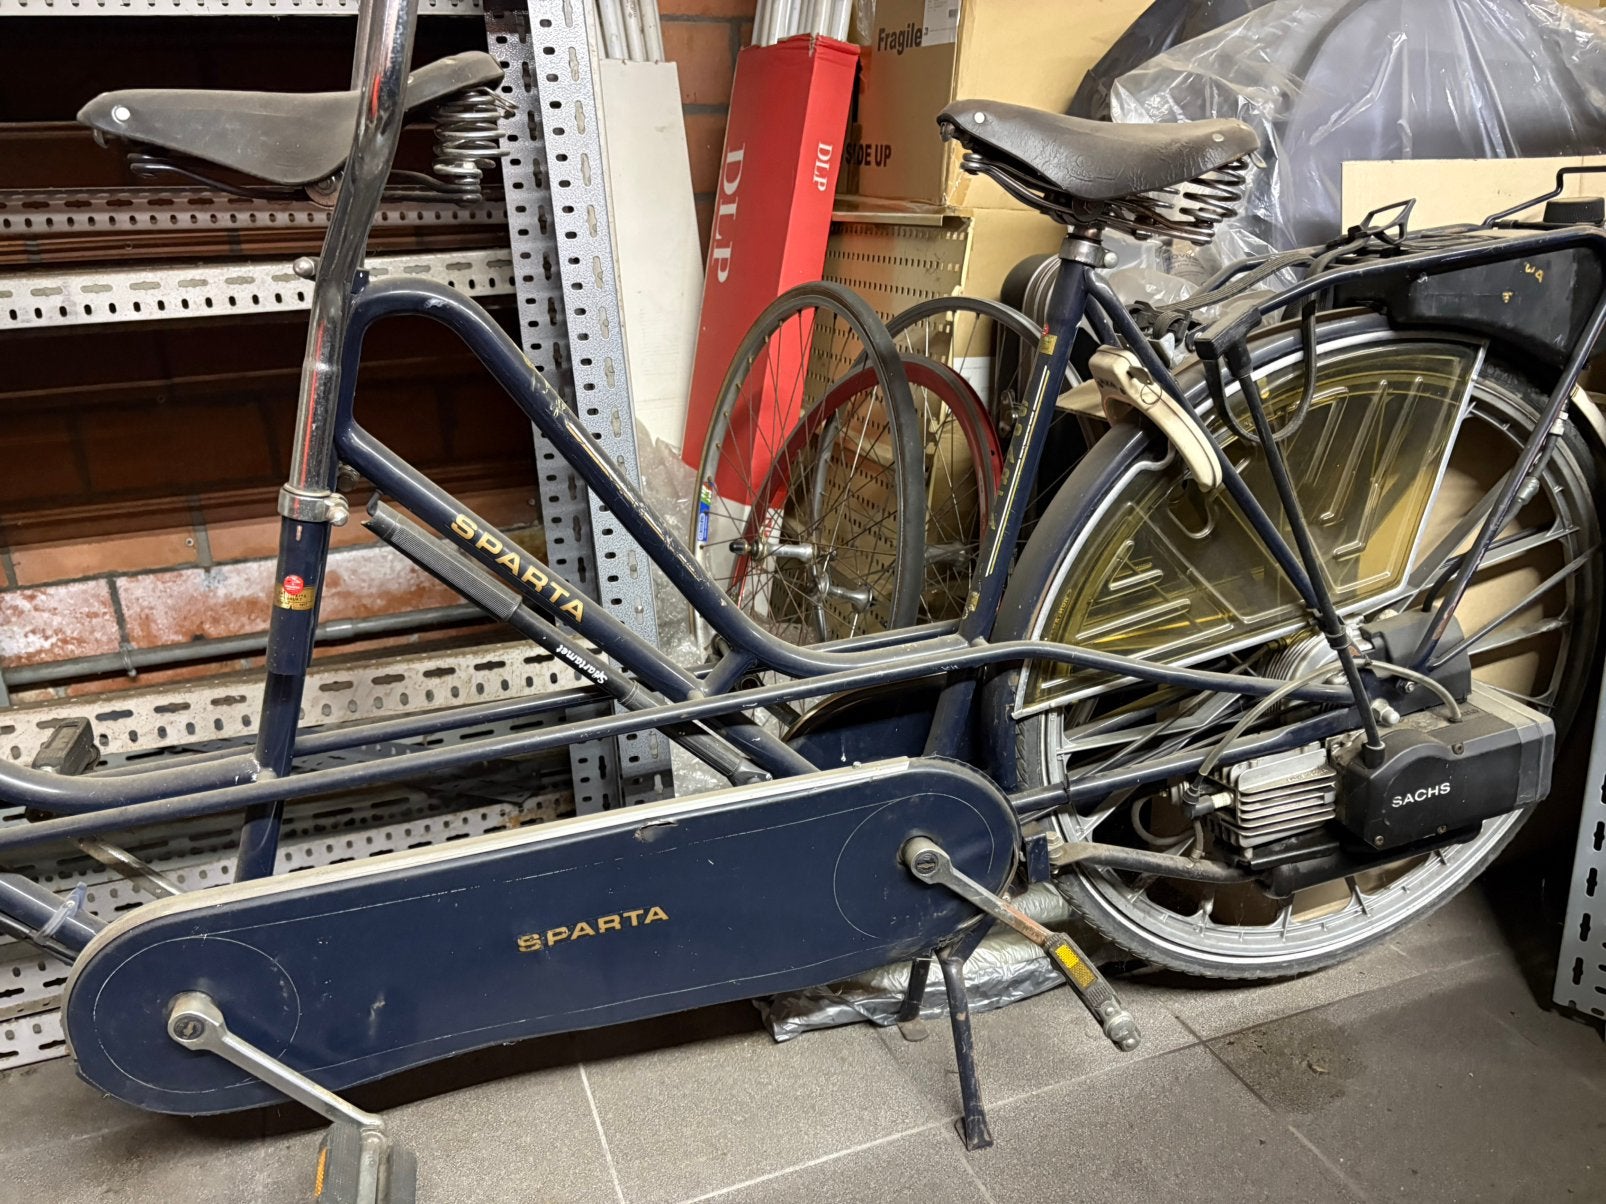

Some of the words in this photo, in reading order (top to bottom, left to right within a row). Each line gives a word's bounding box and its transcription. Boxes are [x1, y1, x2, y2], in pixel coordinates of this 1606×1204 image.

[877, 22, 923, 55] Fragile
[813, 142, 833, 192] DLP
[845, 143, 872, 166] SIDE
[875, 144, 892, 167] UP
[712, 143, 745, 283] DLP
[451, 513, 585, 624] SPARTA
[556, 644, 608, 685] Spartamet
[1391, 782, 1451, 808] SACHS
[517, 906, 670, 952] SPARTA
